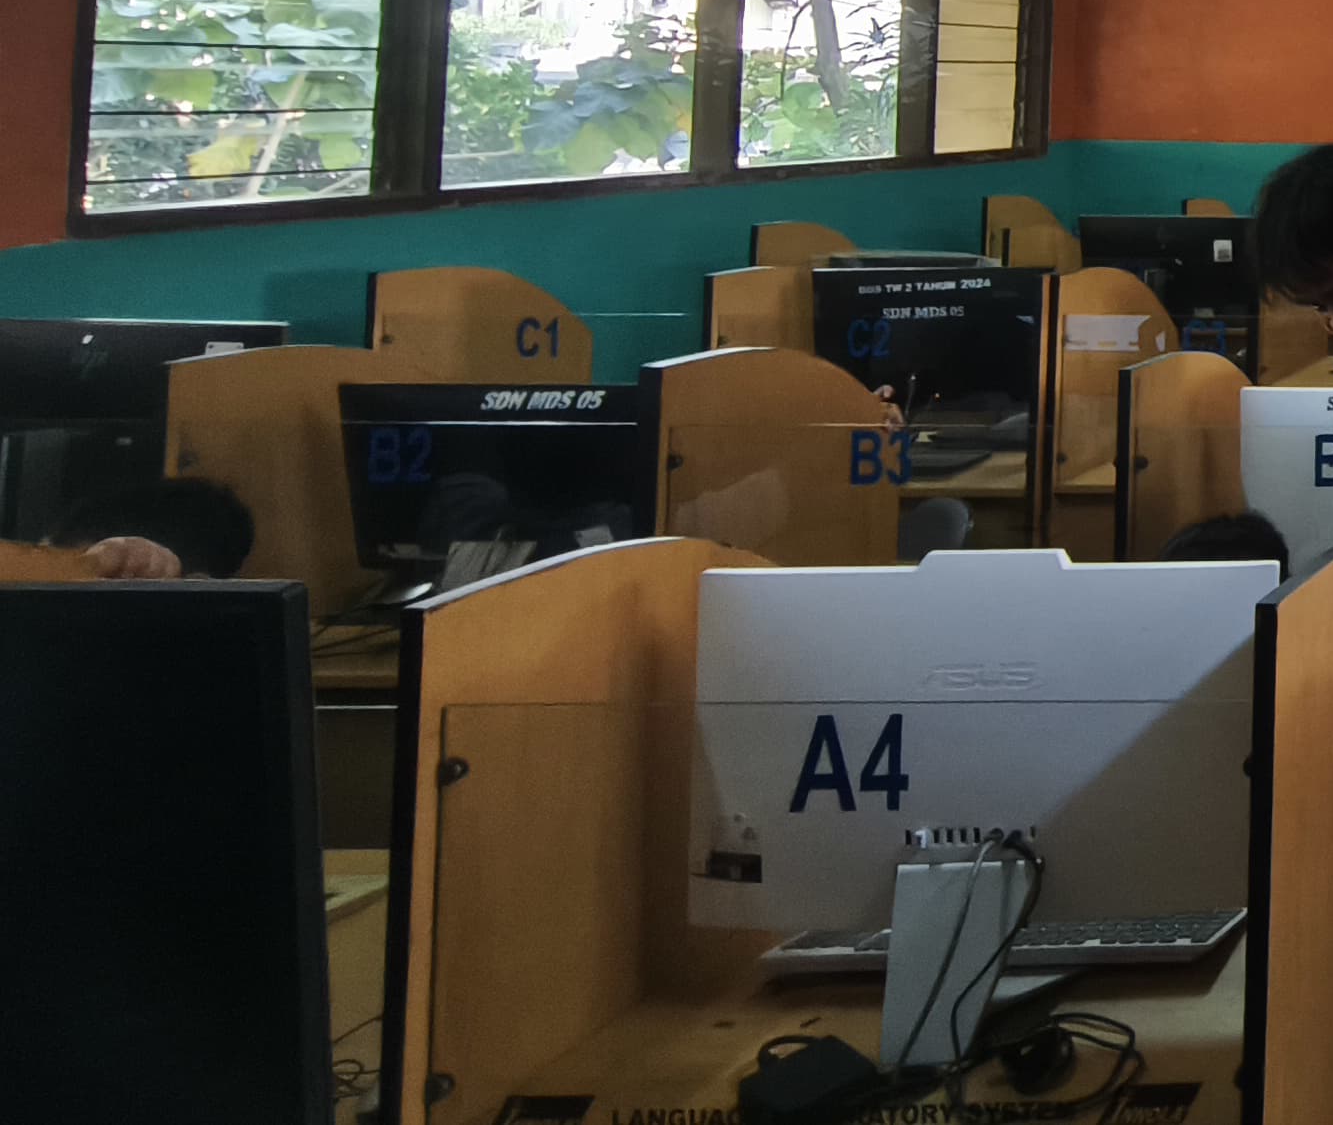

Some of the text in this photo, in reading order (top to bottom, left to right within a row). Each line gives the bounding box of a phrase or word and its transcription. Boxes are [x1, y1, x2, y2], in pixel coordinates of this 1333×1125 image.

[884, 283, 903, 294] TW
[905, 282, 912, 292] 2
[959, 277, 992, 290] 2024
[882, 305, 965, 319] SDN MDS 05
[515, 317, 560, 358] C1
[847, 317, 892, 359] C2
[480, 390, 608, 411] SDN MDS 05
[367, 426, 433, 484] B2
[850, 429, 914, 486] B3
[789, 713, 909, 813] A4
